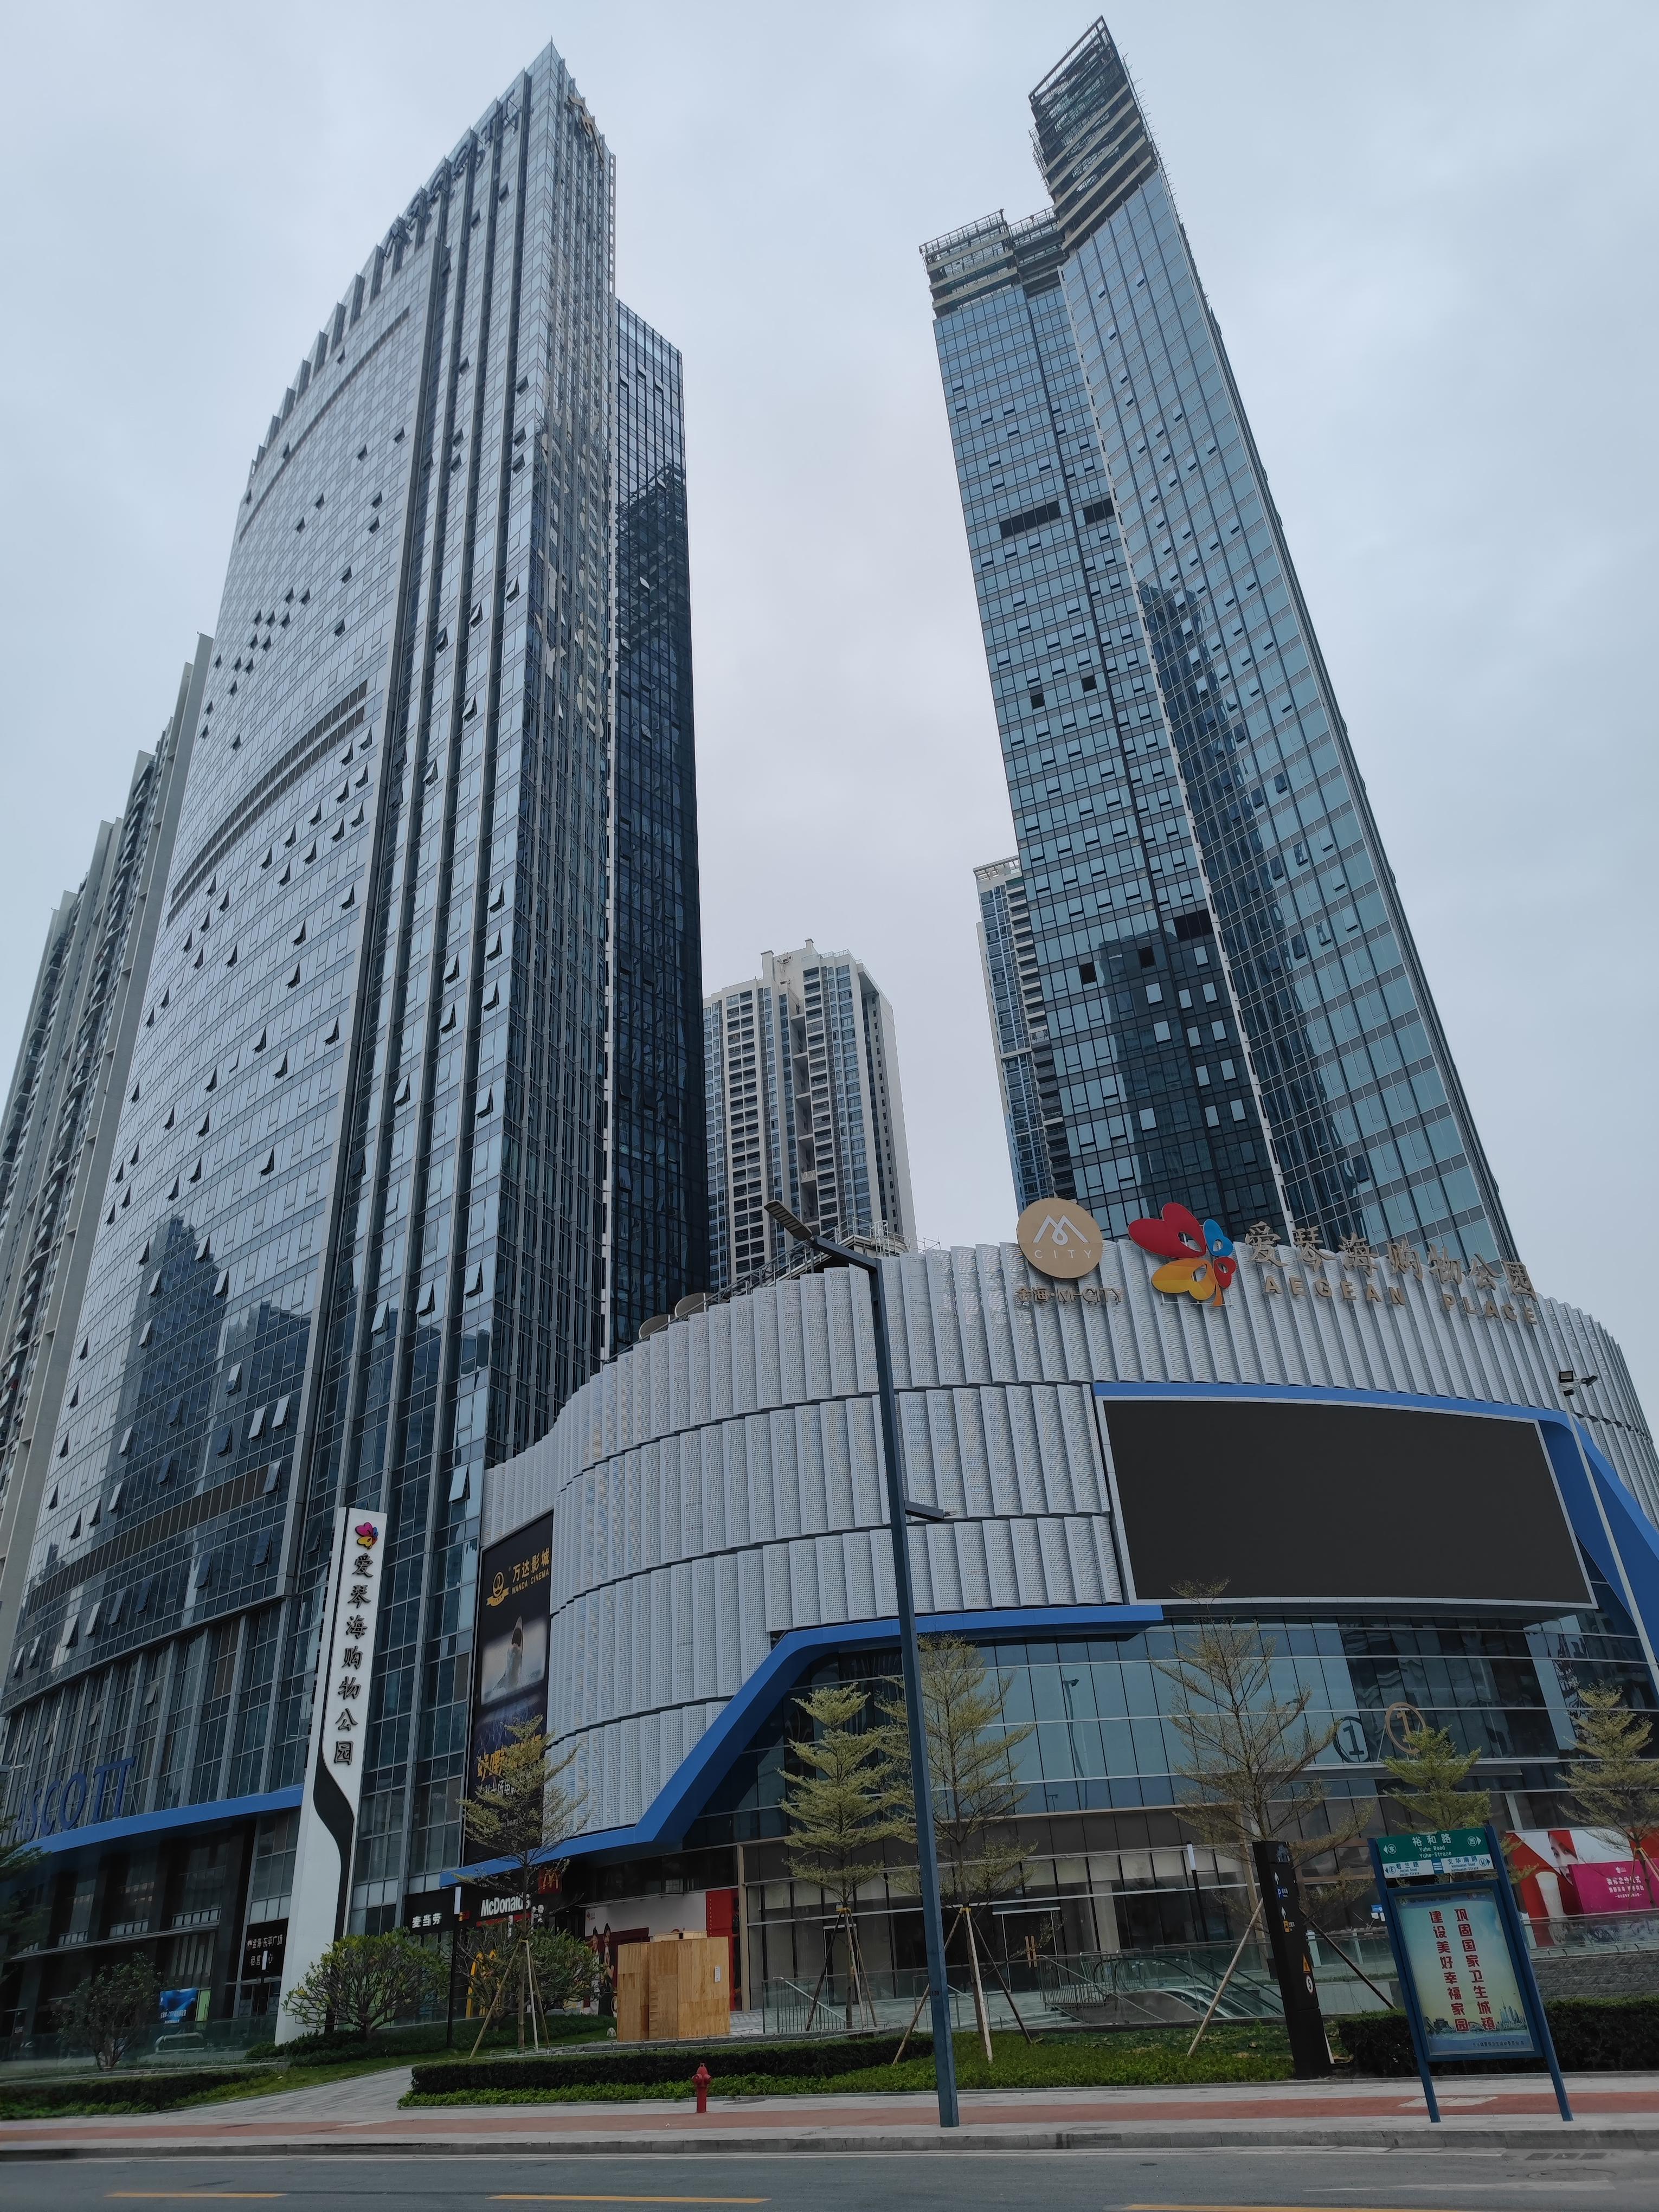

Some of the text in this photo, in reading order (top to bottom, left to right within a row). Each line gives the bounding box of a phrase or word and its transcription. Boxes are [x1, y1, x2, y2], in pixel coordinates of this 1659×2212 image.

[1034, 1249, 1091, 1259] CITY
[1245, 1221, 1536, 1301] 爱琴海购物公园
[1265, 1276, 1538, 1325] AEGEAN PLACE
[512, 1547, 550, 1583] 万达影城
[511, 1568, 549, 1594] WANDA CINEMA
[333, 1553, 374, 1765] 爱琴海购物公园
[11, 1756, 137, 1842] ASCOTT
[1412, 1833, 1452, 1847] 裕和路
[1447, 1856, 1478, 1865] 文华南路
[480, 1891, 532, 1917] McDonalds
[412, 1912, 442, 1928] 麦当劳
[251, 1953, 273, 1966] 租售心
[1429, 1910, 1470, 2032] 建设美好幸福家园
[1454, 1908, 1497, 2030] 巩固国家卫生城镇
